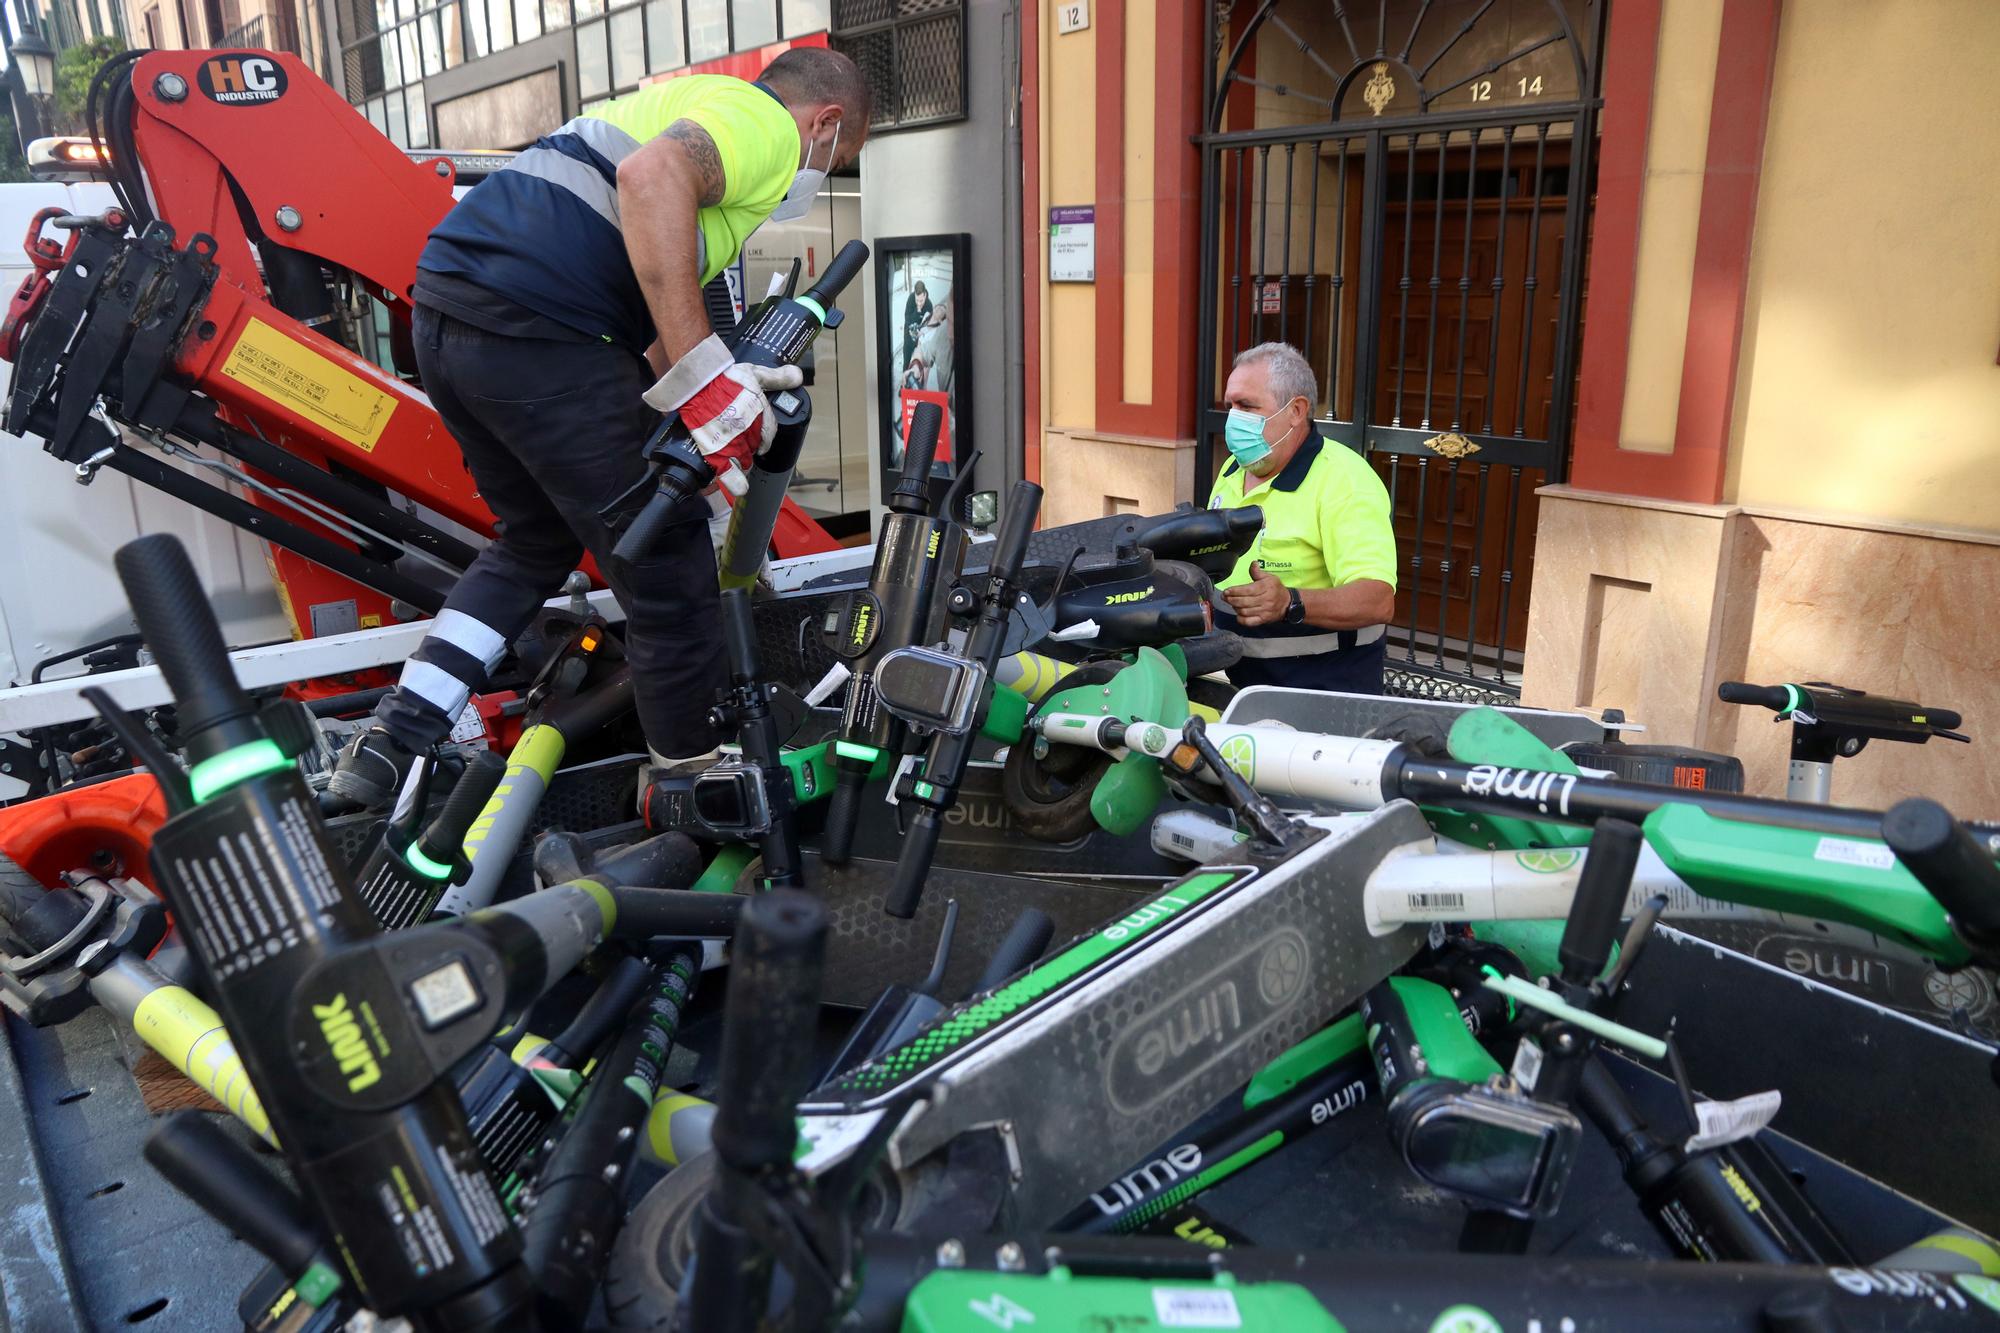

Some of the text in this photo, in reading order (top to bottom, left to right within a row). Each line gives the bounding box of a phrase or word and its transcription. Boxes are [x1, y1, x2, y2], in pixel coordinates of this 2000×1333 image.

[1066, 7, 1079, 26] 12
[208, 59, 277, 92] HC
[215, 90, 280, 102] INDUSTRIE
[1470, 75, 1543, 103] 12 14
[926, 529, 941, 559] LINK
[1190, 542, 1230, 556] LINK
[853, 605, 871, 646] LINK
[1465, 764, 1578, 816] Lime
[943, 800, 1012, 839] ime
[1103, 896, 1191, 940] Lime
[1784, 949, 1892, 996] Lime
[312, 992, 381, 1092] LINK
[1136, 980, 1241, 1075] Lime
[1311, 1080, 1366, 1125] Lime
[1090, 1143, 1203, 1216] Lime
[1721, 1164, 1760, 1212] LINK
